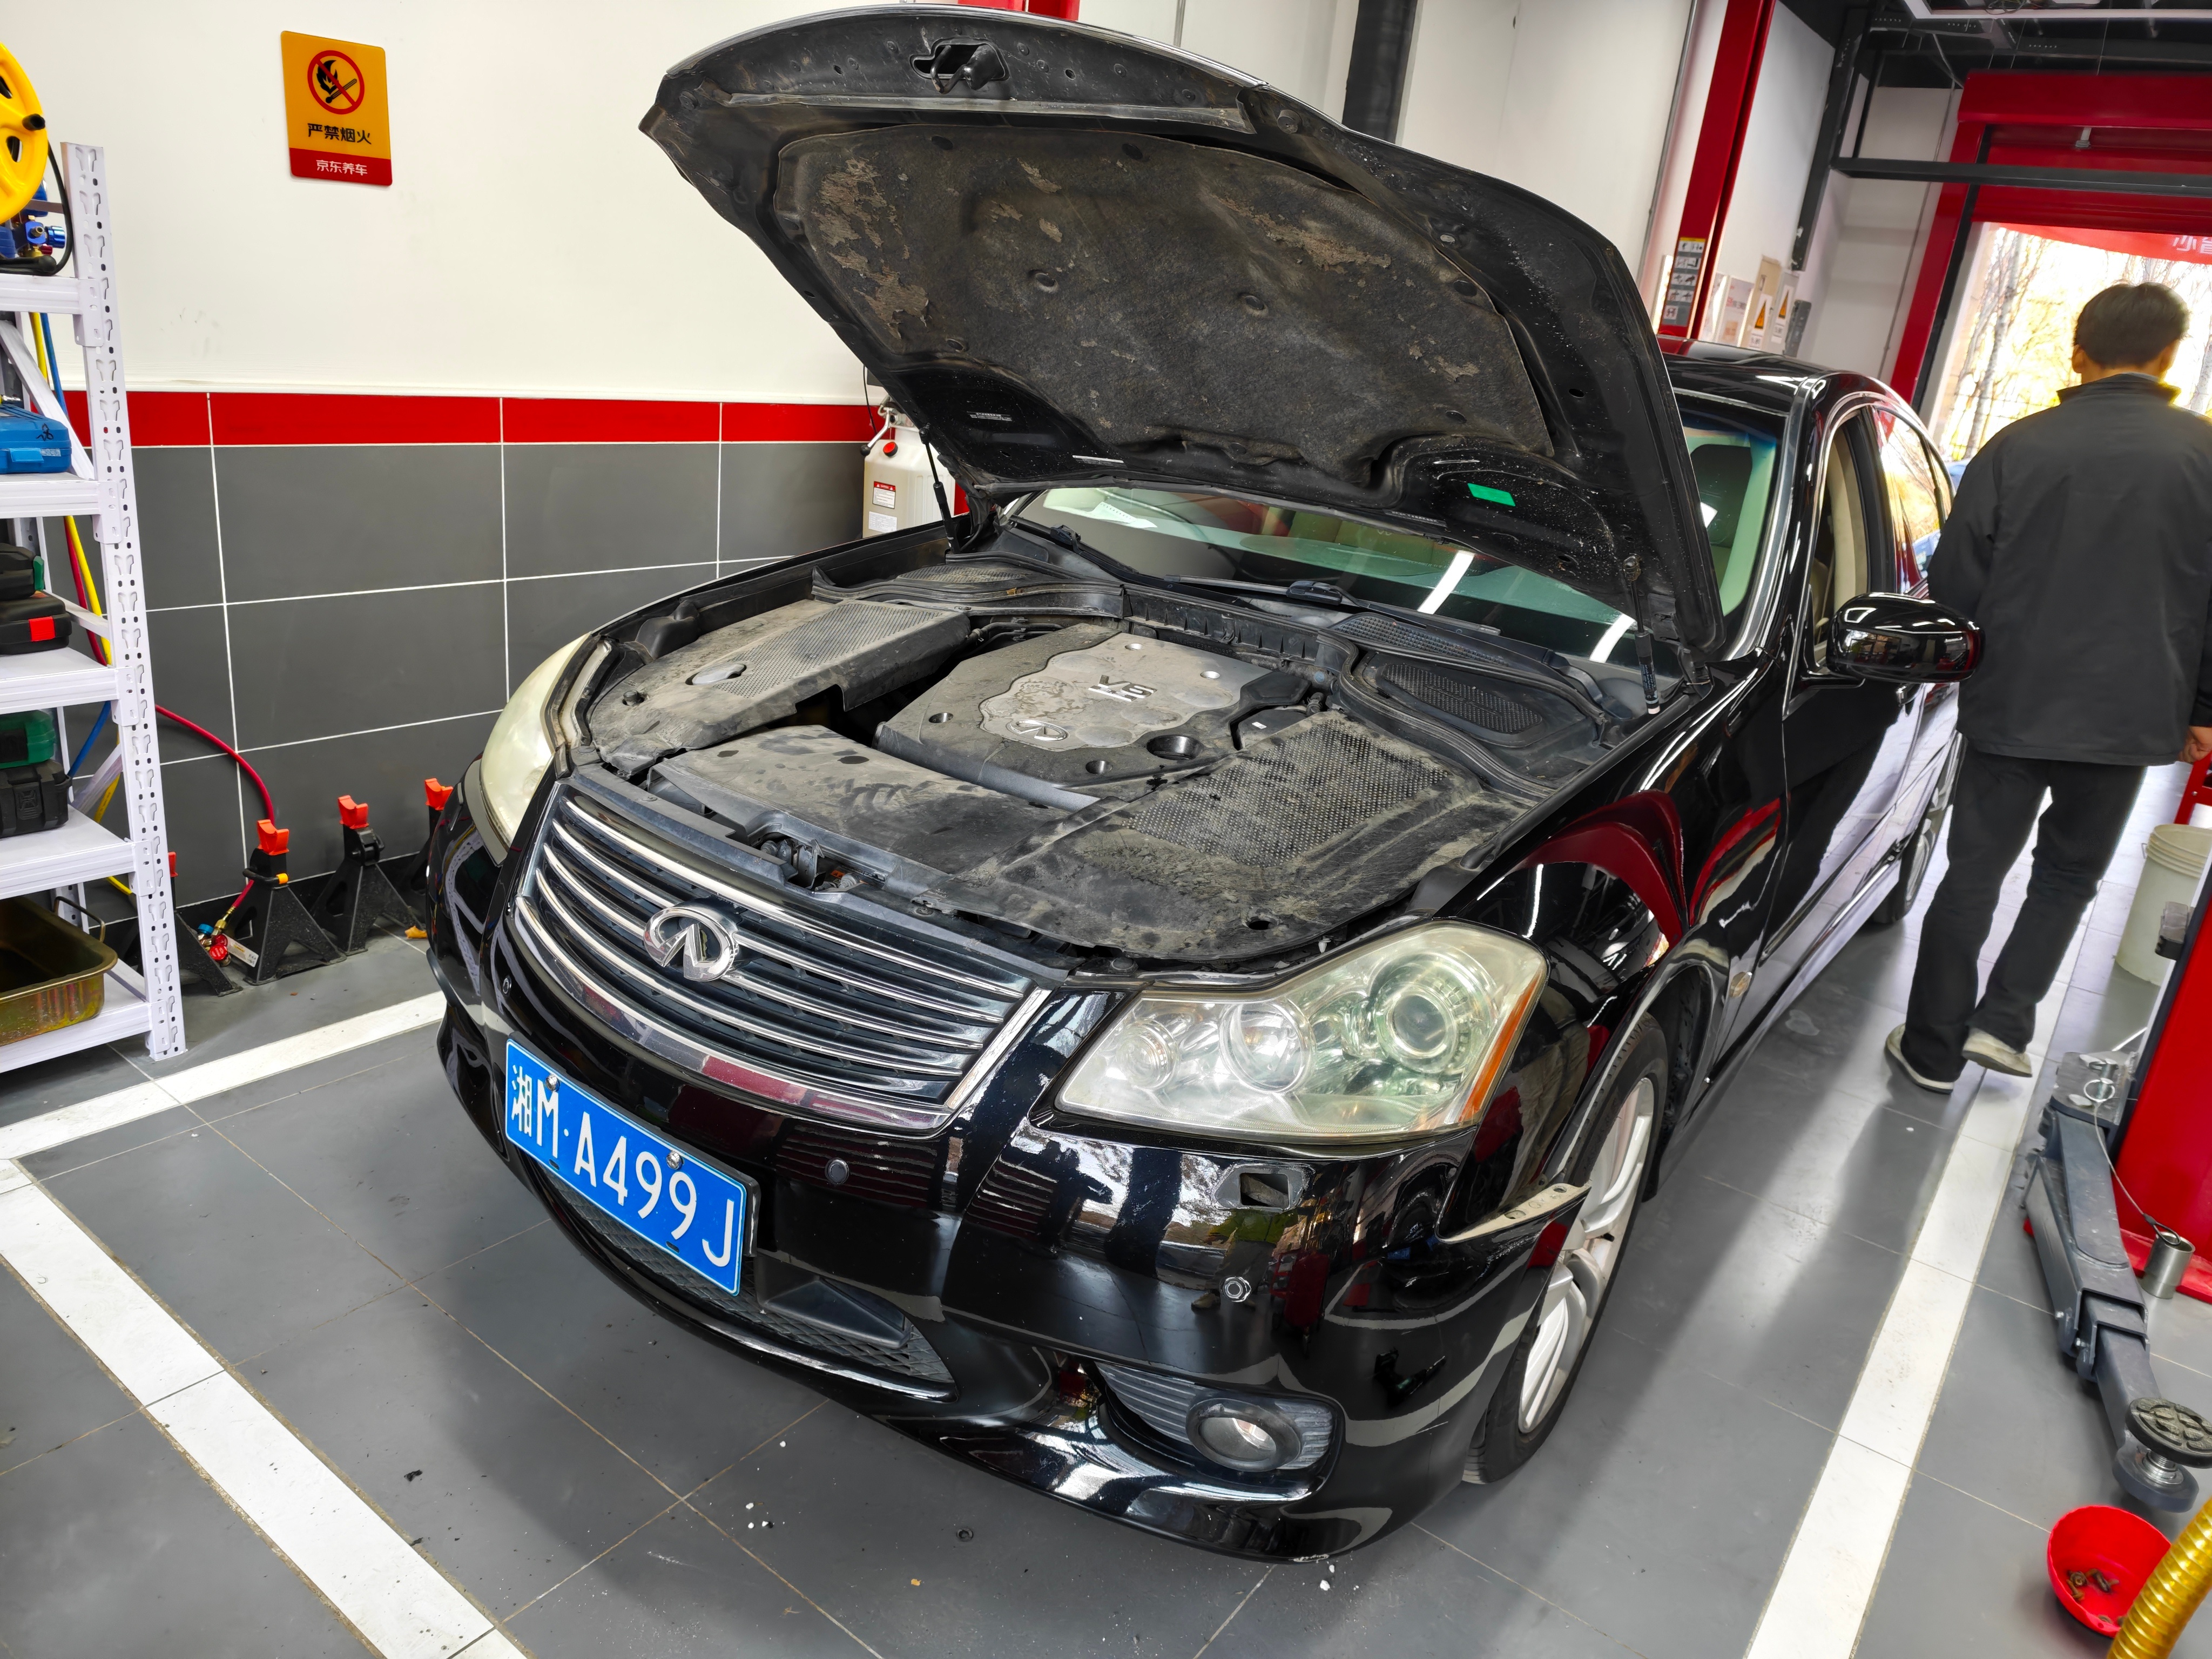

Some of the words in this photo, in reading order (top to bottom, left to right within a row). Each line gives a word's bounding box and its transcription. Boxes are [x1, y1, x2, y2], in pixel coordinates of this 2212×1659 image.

[307, 123, 372, 145] 严禁烟火
[316, 159, 368, 176] 京东养车
